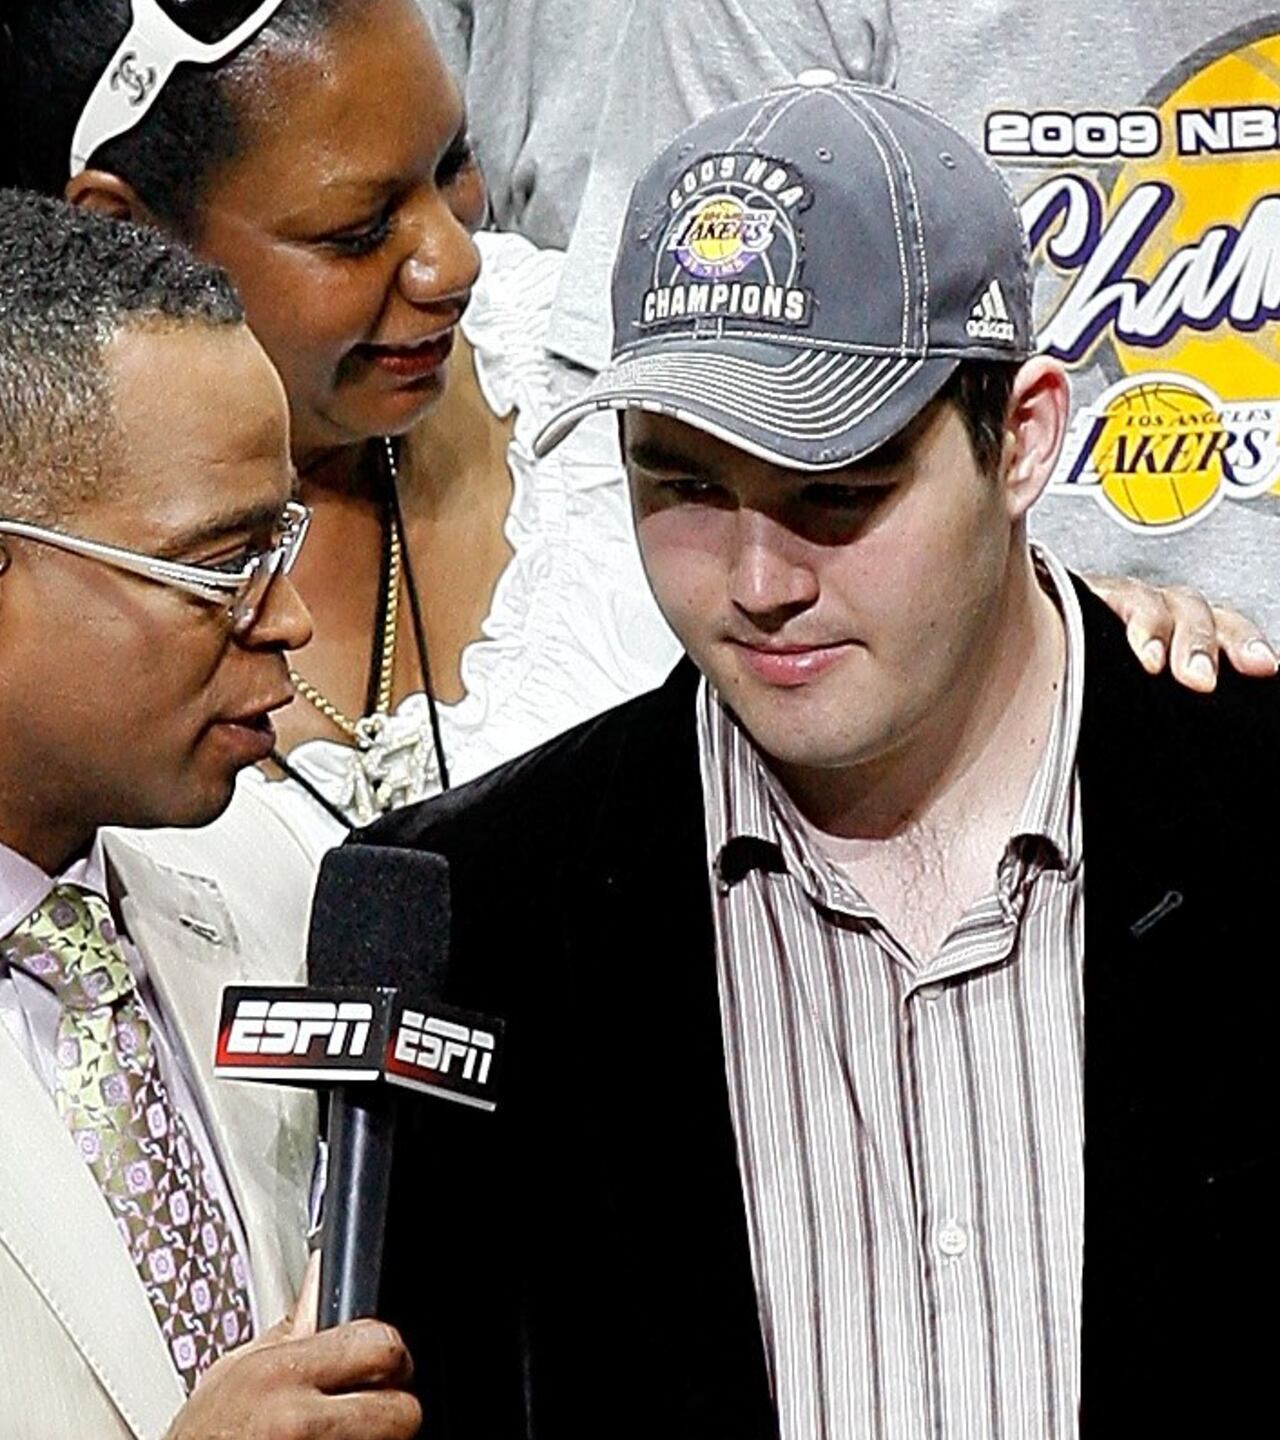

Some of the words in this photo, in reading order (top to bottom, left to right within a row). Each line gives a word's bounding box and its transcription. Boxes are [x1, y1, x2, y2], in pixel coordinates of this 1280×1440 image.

[985, 109, 1161, 159] 2009
[670, 156, 735, 210] 2009
[743, 158, 804, 208] NBA
[644, 282, 805, 323] CHAMPIONS
[1126, 414, 1164, 428] LOS
[1170, 408, 1271, 426] ANGELES
[1058, 415, 1272, 487] LAKERS
[226, 999, 373, 1056] ESPN
[394, 1008, 496, 1084] ESPN
